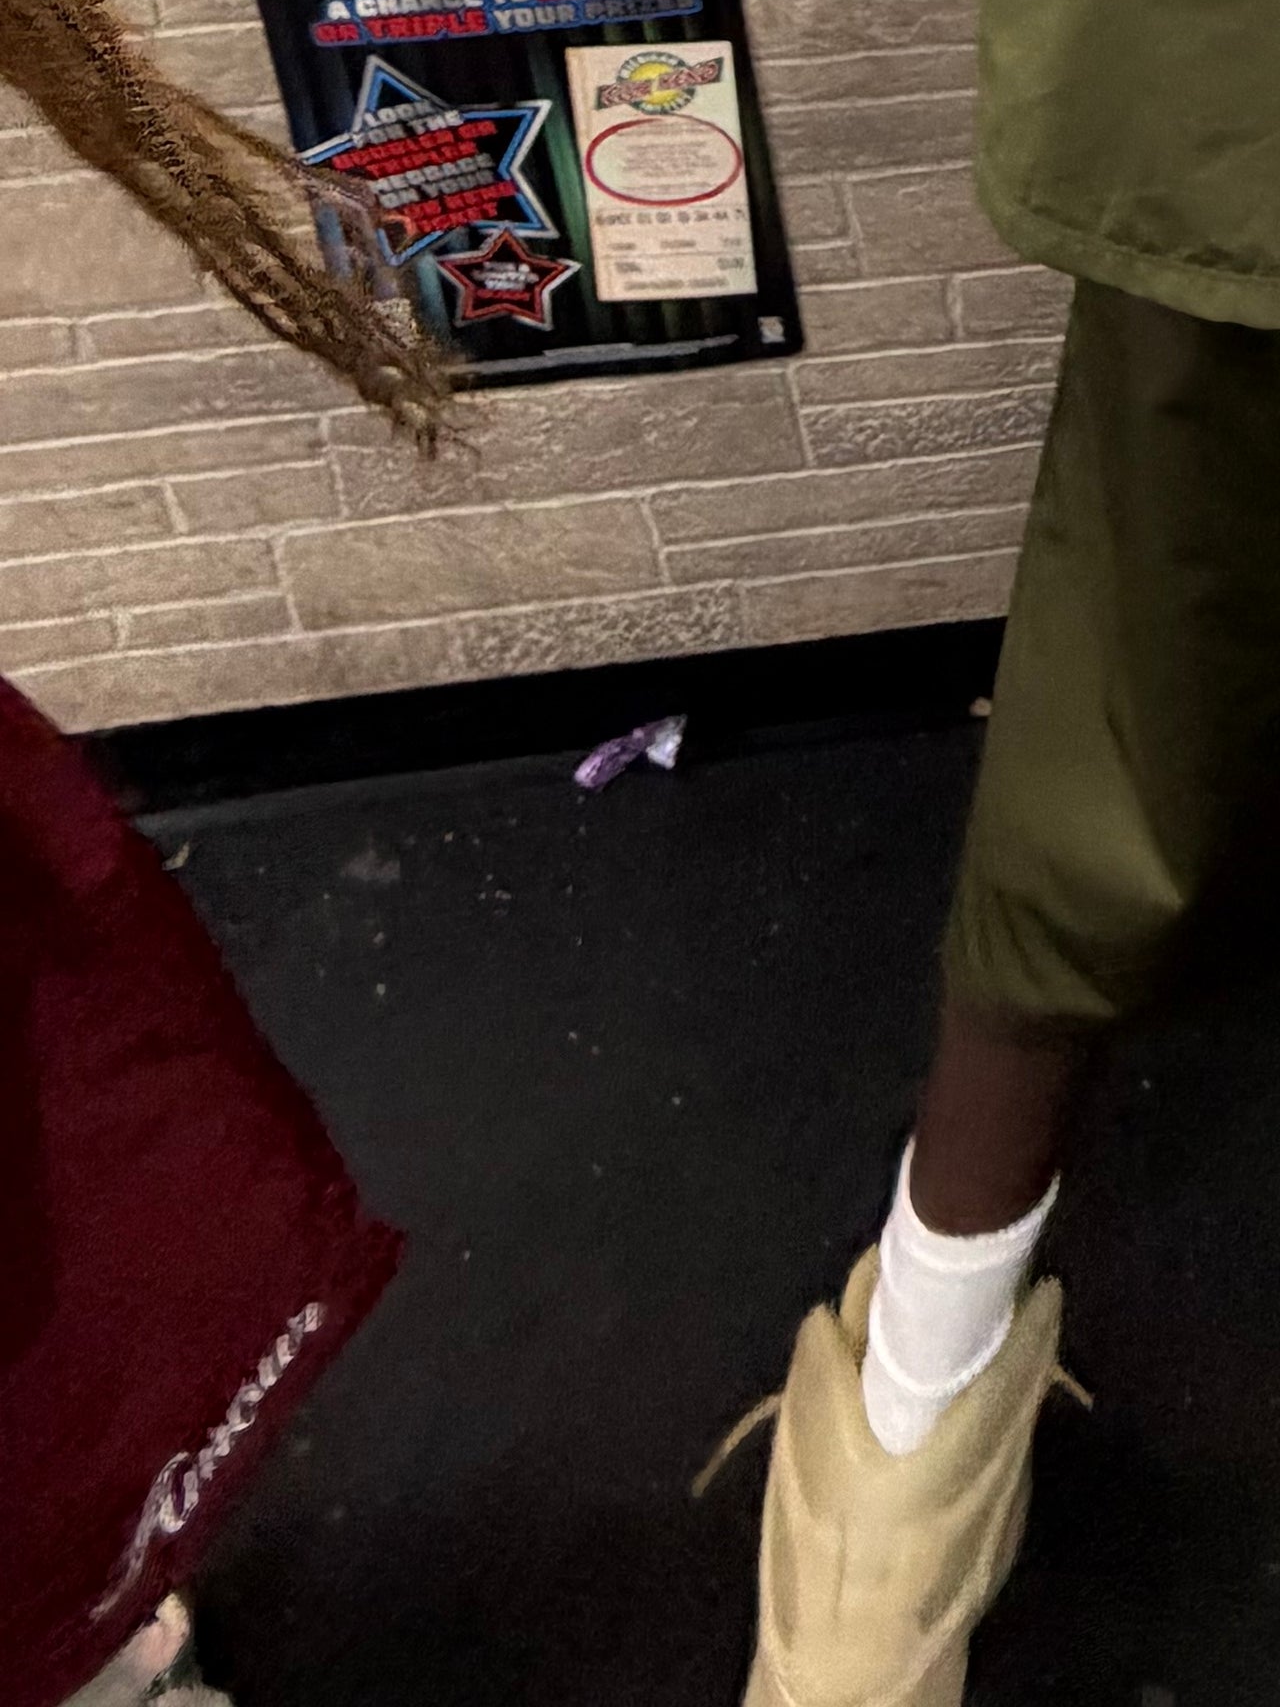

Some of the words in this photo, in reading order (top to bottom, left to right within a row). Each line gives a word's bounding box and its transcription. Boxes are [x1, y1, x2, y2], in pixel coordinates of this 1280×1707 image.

[313, 20, 360, 43] OR
[361, 7, 489, 40] TRIPLE
[492, 3, 577, 31] YOUR
[327, 0, 351, 20] A
